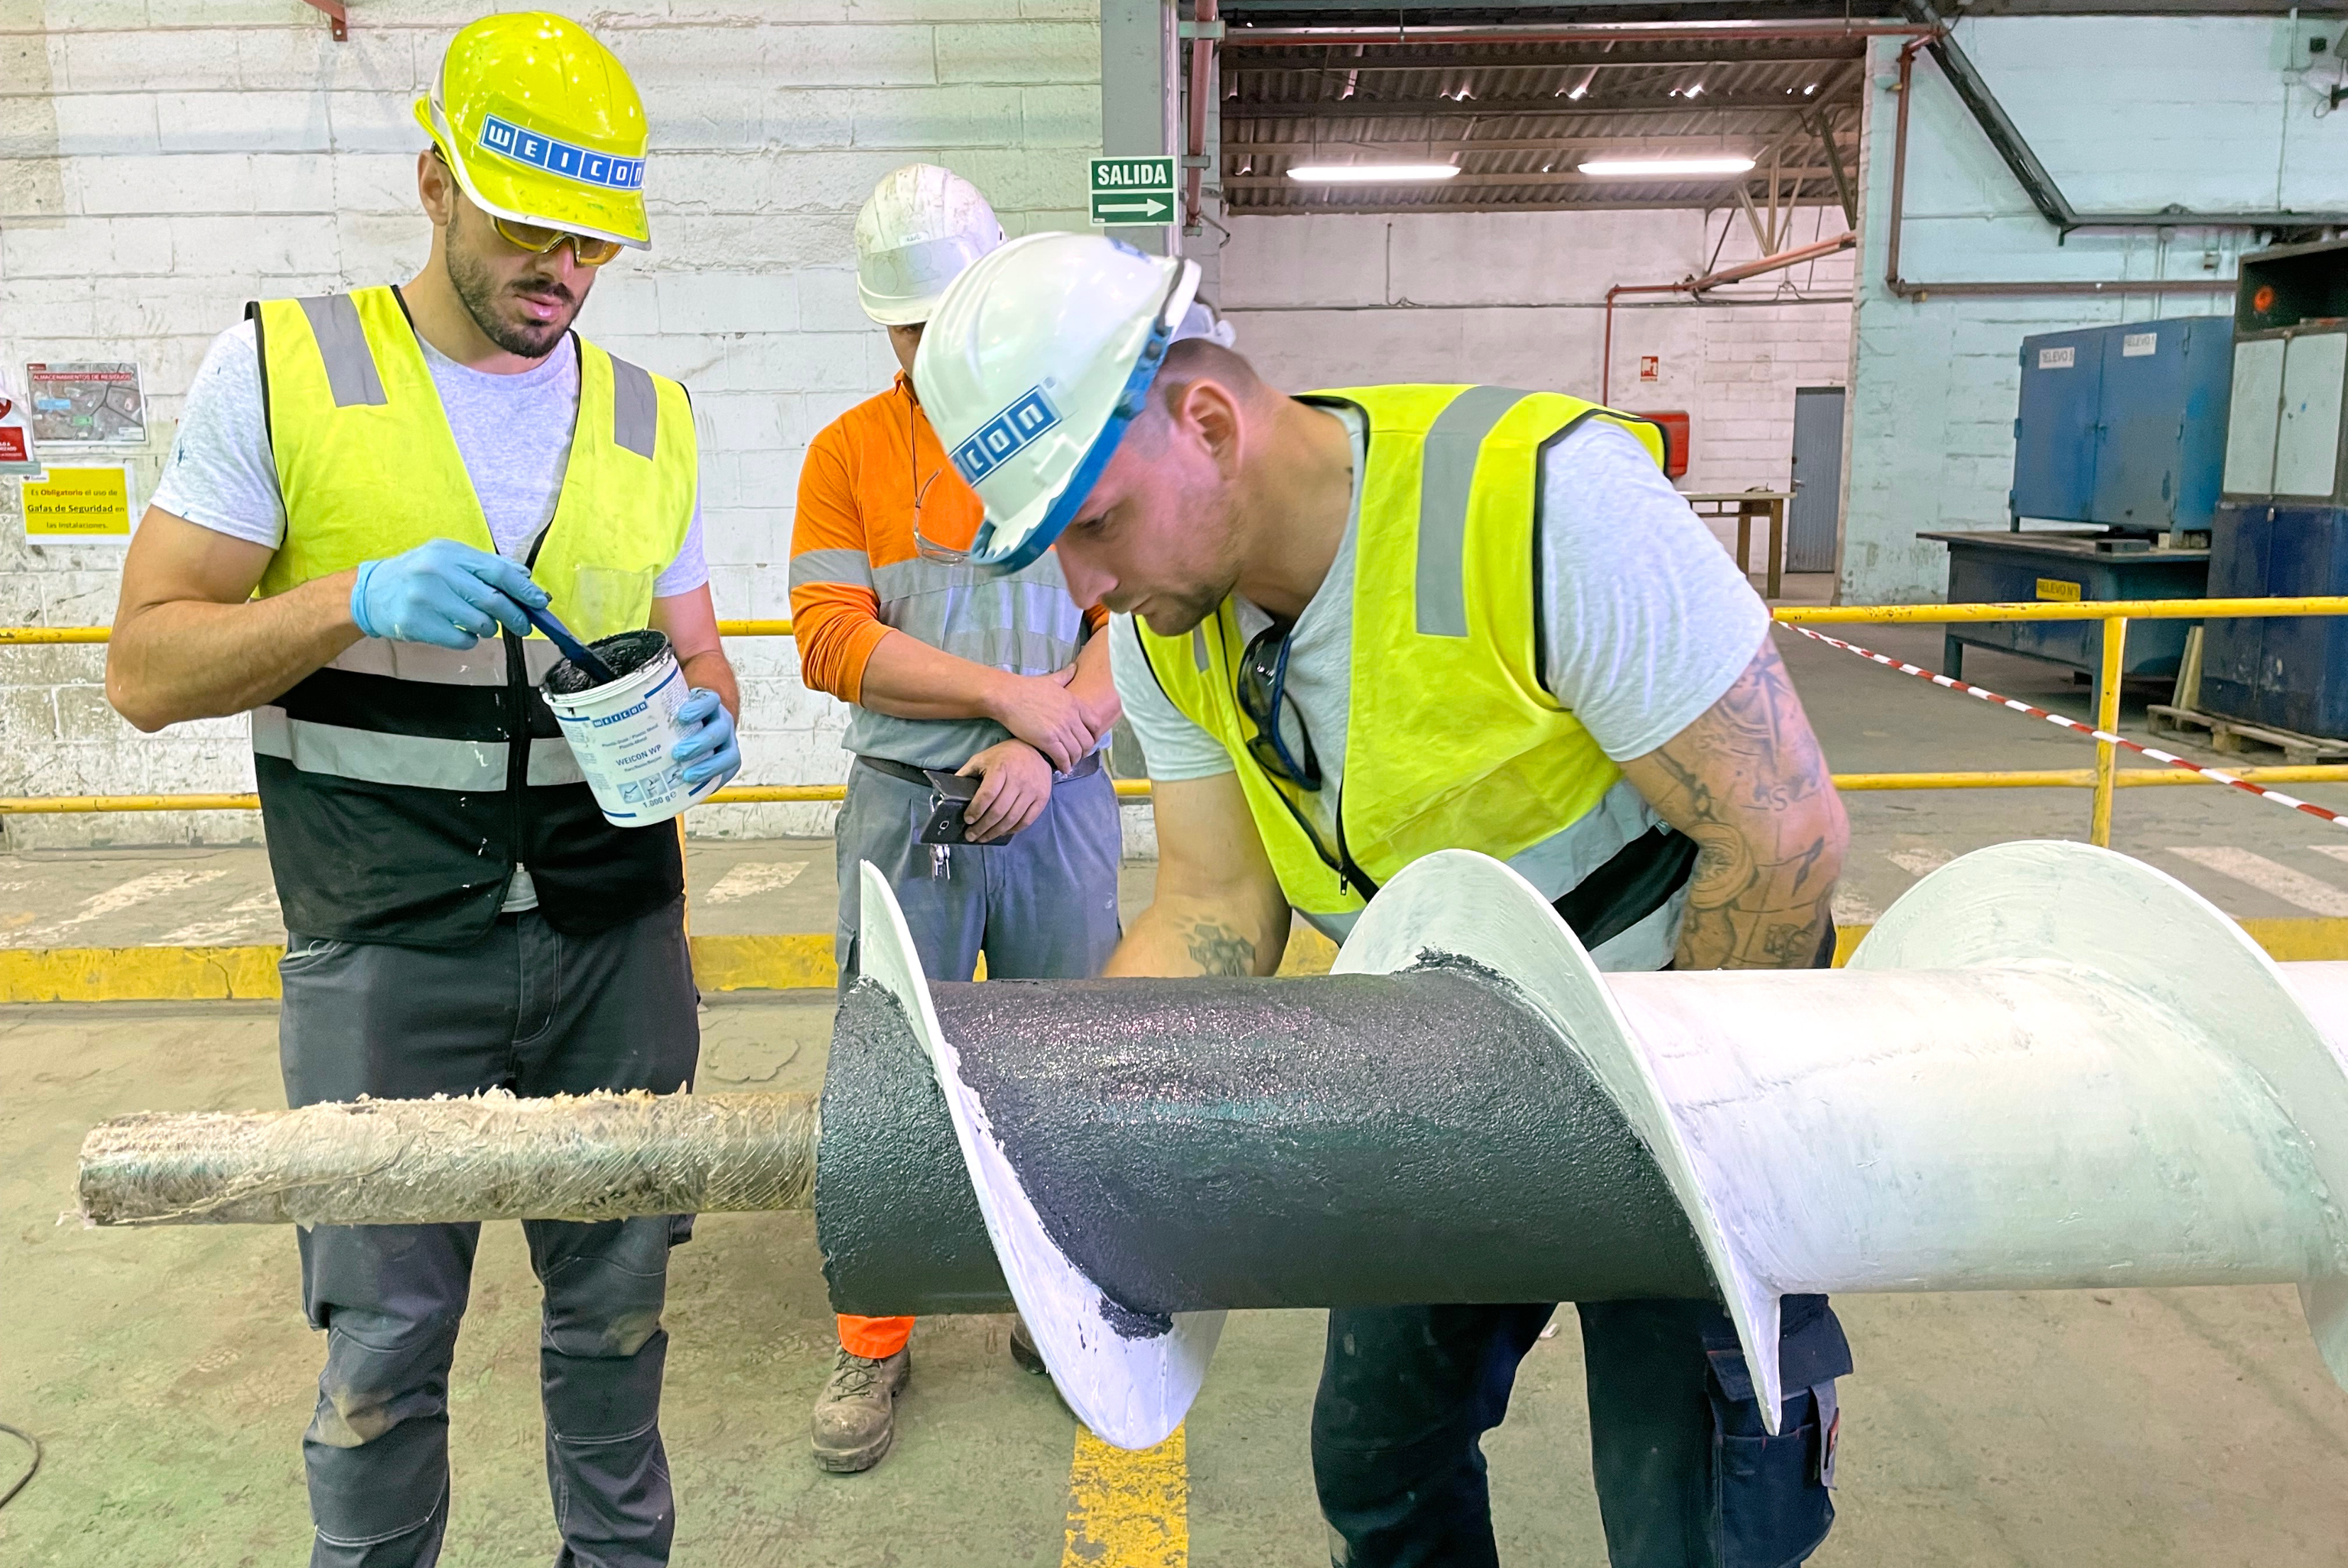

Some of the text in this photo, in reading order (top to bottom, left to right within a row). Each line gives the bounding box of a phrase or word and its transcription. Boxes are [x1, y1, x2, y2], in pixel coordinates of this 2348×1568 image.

[1097, 164, 1167, 185] SALIDA
[68, 504, 113, 513] Seguridad
[594, 702, 647, 726] WEICON
[616, 744, 662, 767] WEICON WP
[643, 796, 664, 808] 1.000
